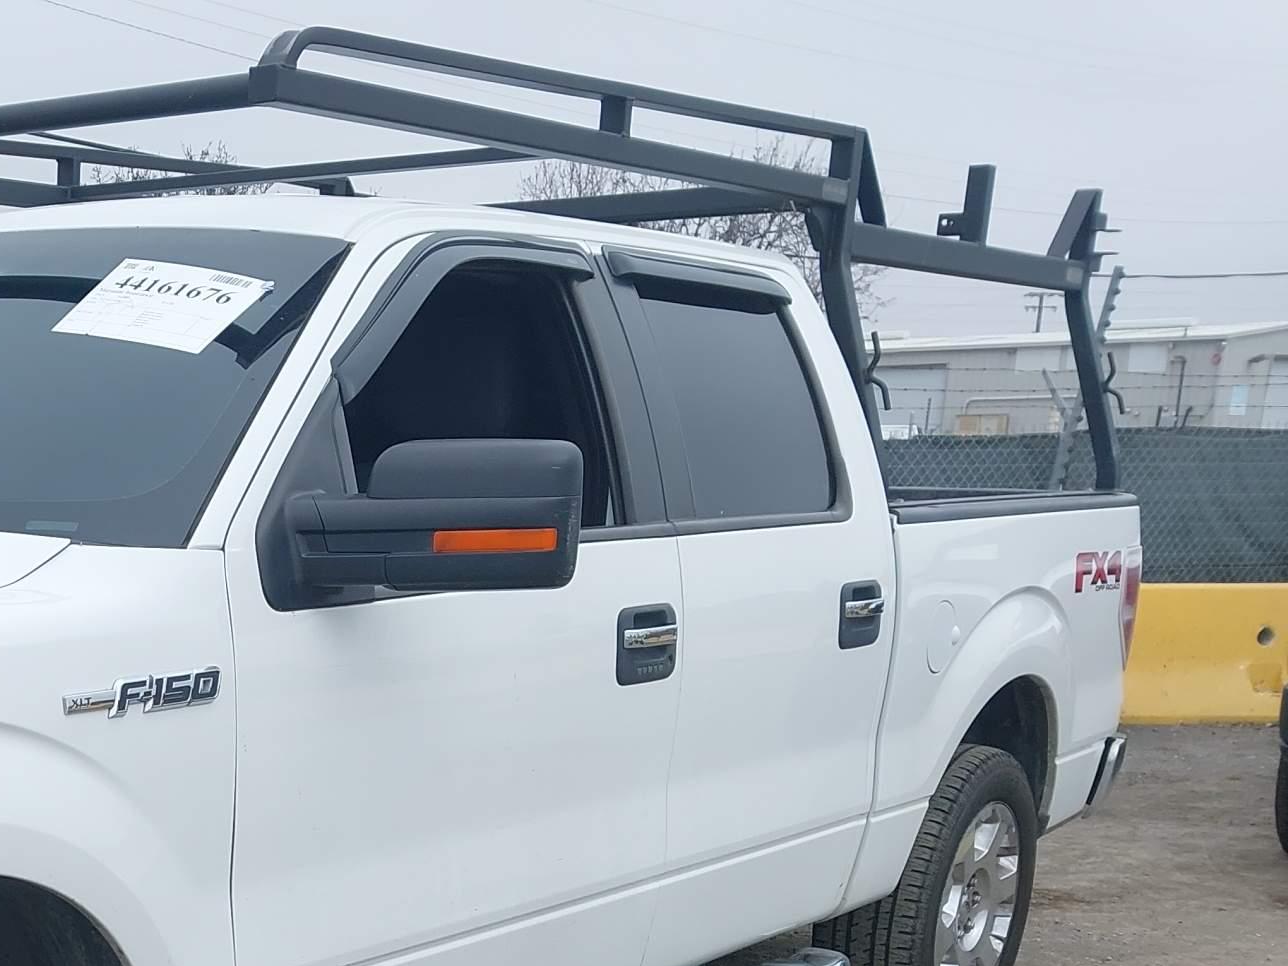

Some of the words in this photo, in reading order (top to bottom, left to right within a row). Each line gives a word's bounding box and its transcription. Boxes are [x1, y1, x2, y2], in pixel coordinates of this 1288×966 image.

[115, 275, 239, 305] 44161676
[1074, 550, 1122, 593] FX4
[70, 696, 93, 710] XLT
[110, 667, 222, 718] F-150
